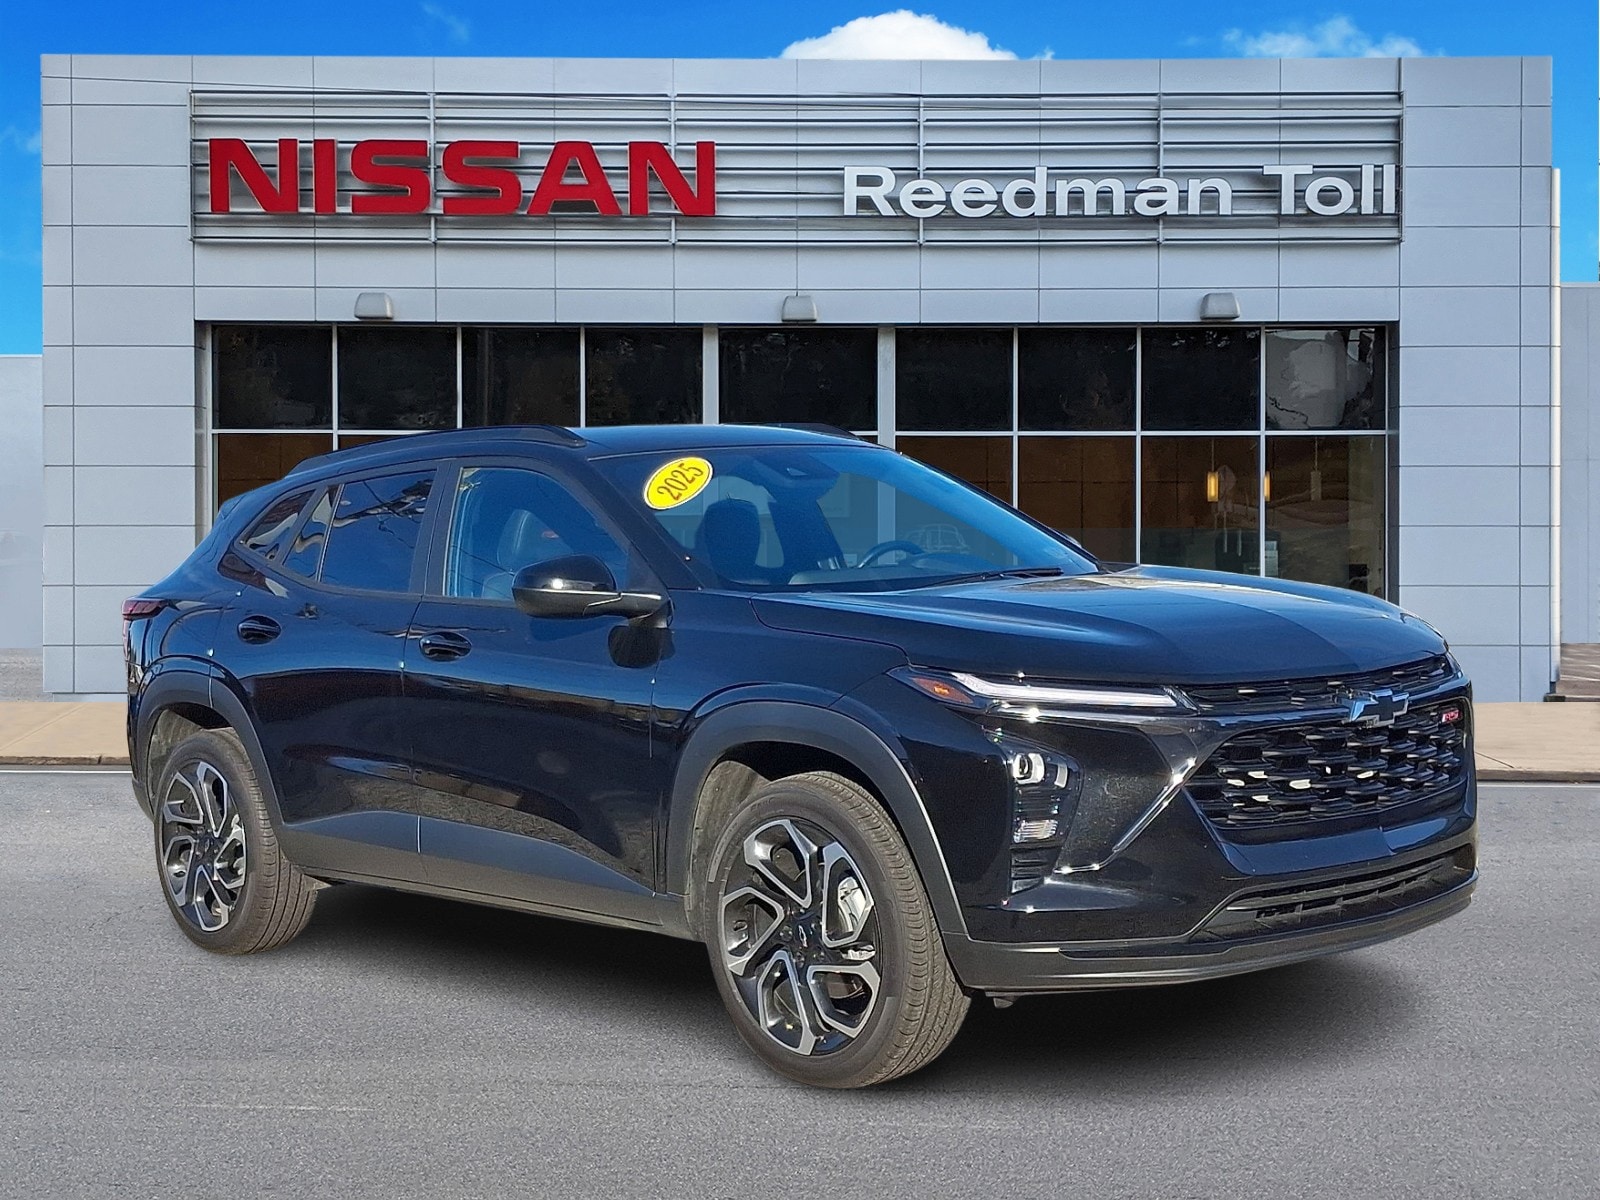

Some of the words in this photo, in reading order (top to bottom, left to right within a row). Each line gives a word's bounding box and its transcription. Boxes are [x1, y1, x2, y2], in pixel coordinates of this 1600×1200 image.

[209, 138, 716, 217] NISSAN
[842, 165, 1233, 218] Reedman
[1262, 164, 1396, 216] Toll
[657, 463, 703, 500] 2025
